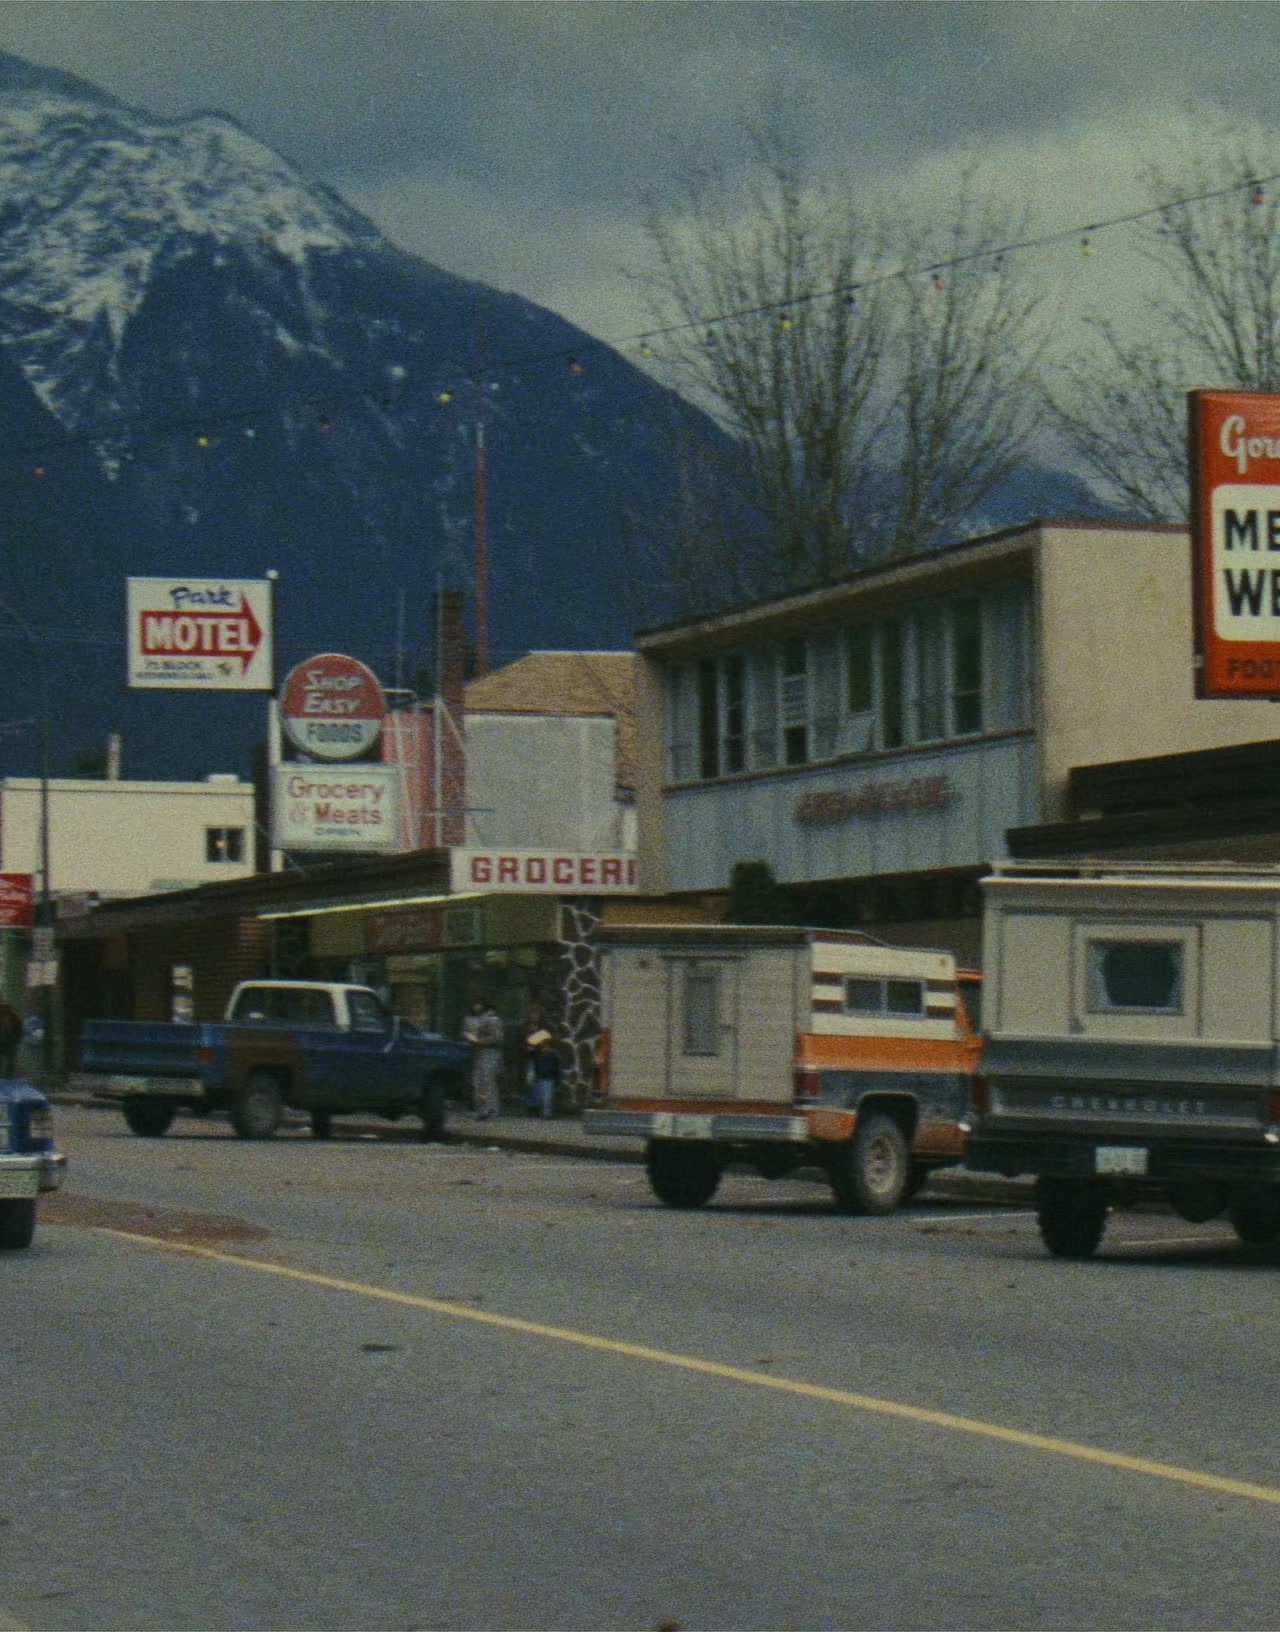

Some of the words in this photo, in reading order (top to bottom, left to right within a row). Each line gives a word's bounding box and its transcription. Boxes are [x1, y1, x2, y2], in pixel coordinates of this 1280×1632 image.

[170, 586, 233, 609] Park
[145, 616, 261, 651] MOTEL
[306, 723, 363, 744] FOODS
[287, 776, 383, 804] Grocery
[314, 802, 382, 825] Meats
